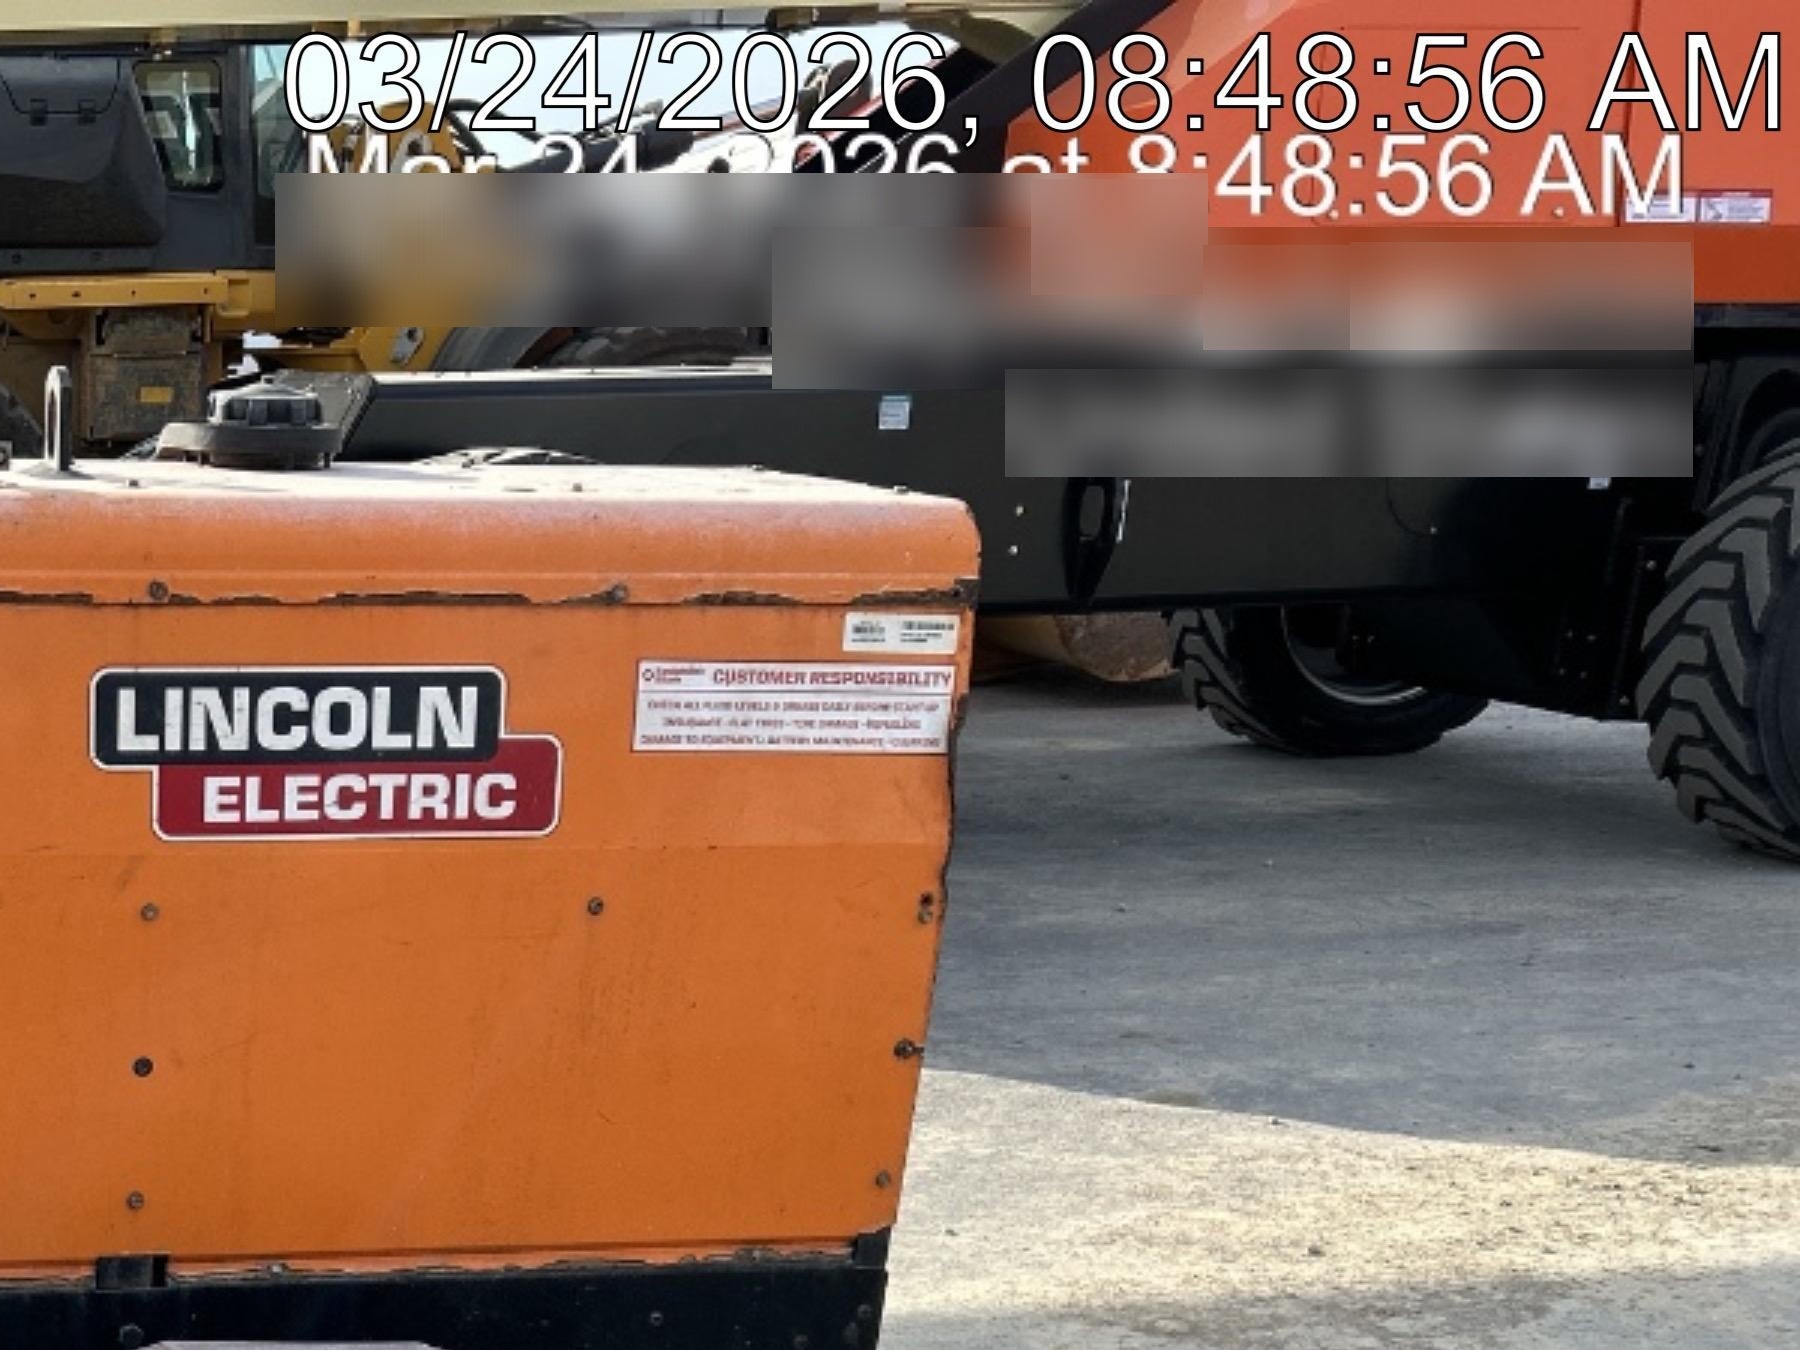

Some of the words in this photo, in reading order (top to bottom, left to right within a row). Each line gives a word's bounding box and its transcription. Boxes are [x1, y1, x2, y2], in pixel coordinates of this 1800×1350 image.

[713, 668, 806, 686] CUSTOMER
[809, 671, 951, 687] RESPONSIBILITY
[115, 686, 479, 752] LINCOLN
[202, 773, 518, 823] ELECTRIC
